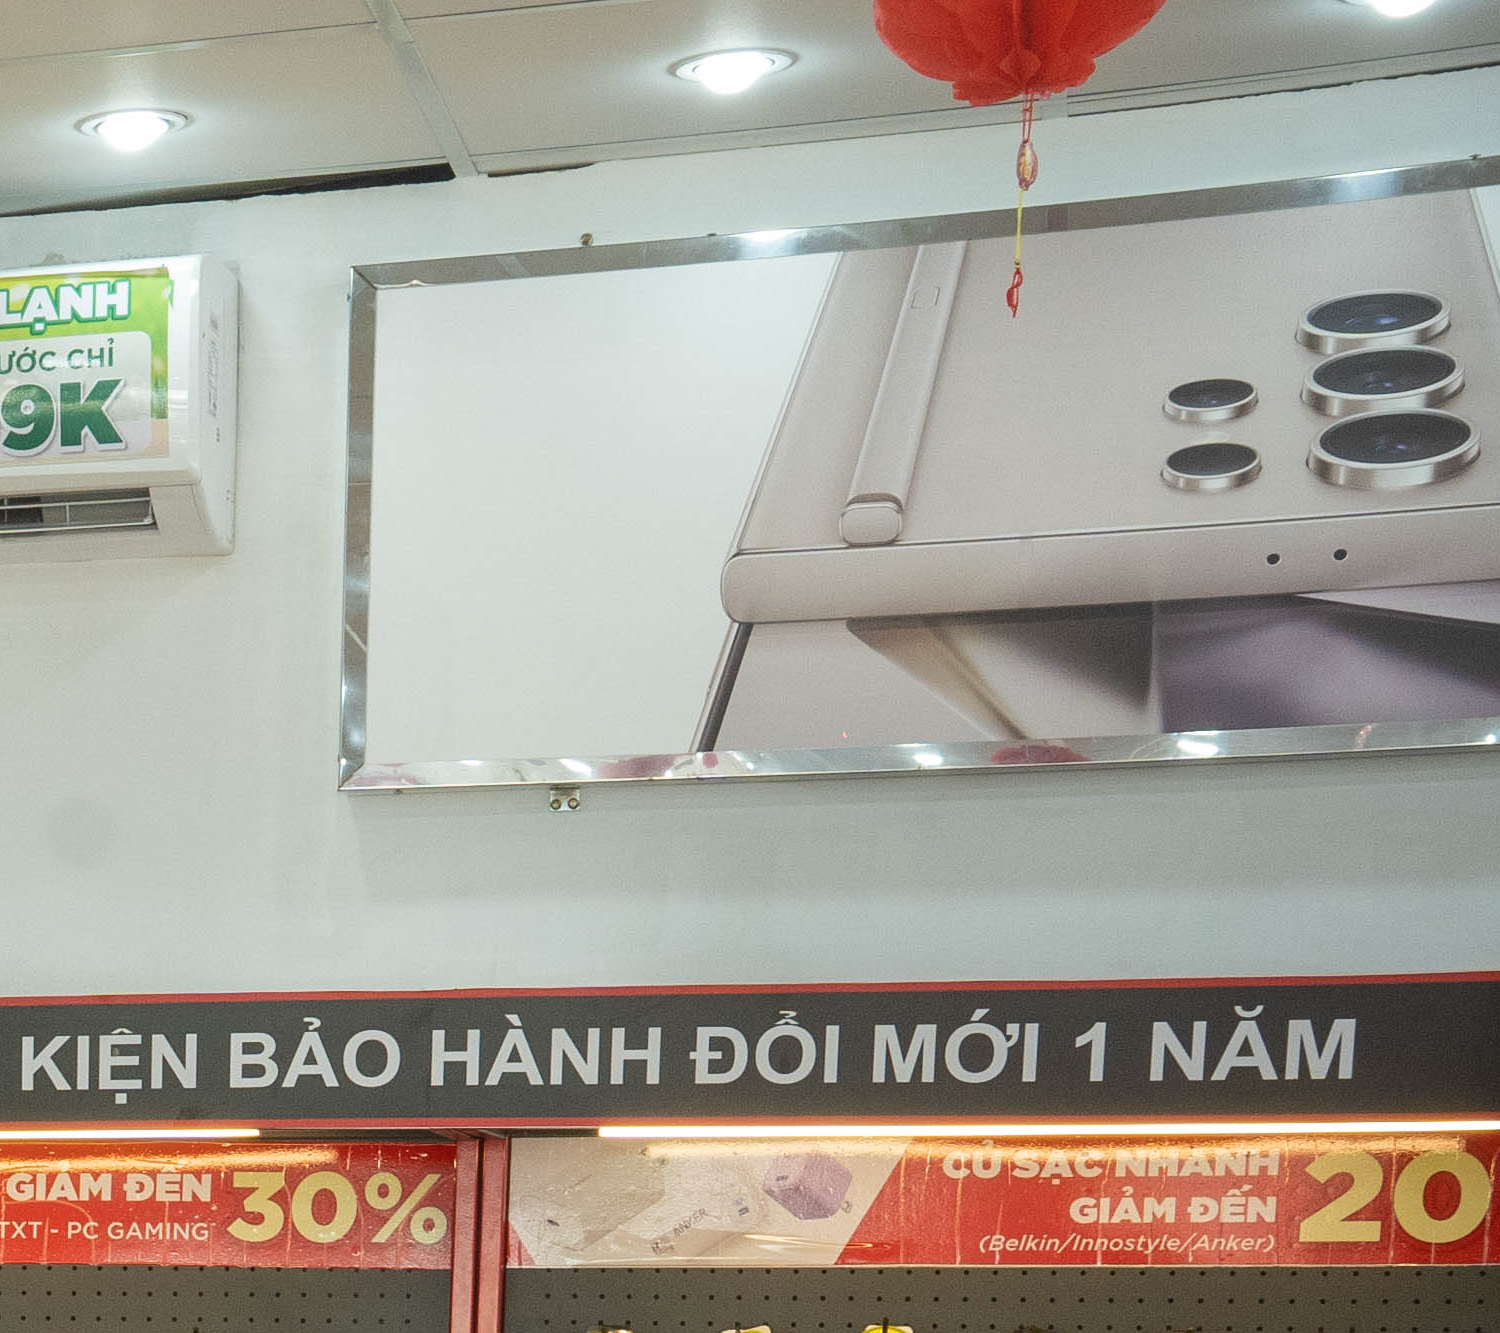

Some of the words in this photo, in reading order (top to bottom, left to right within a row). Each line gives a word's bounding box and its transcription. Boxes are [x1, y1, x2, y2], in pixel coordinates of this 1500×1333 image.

[66, 340, 116, 371] CHỈ
[22, 1025, 197, 1106] KIỆN
[229, 1020, 402, 1089] BẢO
[431, 1015, 662, 1085] HÀNH
[690, 1012, 840, 1085] ĐỔI
[873, 1017, 1041, 1085] MỚI
[1080, 1021, 1106, 1083] 1
[1150, 1006, 1357, 1083] NĂM
[1012, 1152, 1102, 1184] SẠC
[1116, 1152, 1278, 1177] NHANH
[226, 1171, 449, 1244] 30%
[1070, 1186, 1176, 1224] GIẢM
[1187, 1184, 1276, 1223] ĐẾN
[68, 1222, 99, 1240] PC
[108, 1221, 209, 1241] GAMING
[979, 1234, 1275, 1255] (Belkin/Innostyle/Anker)
